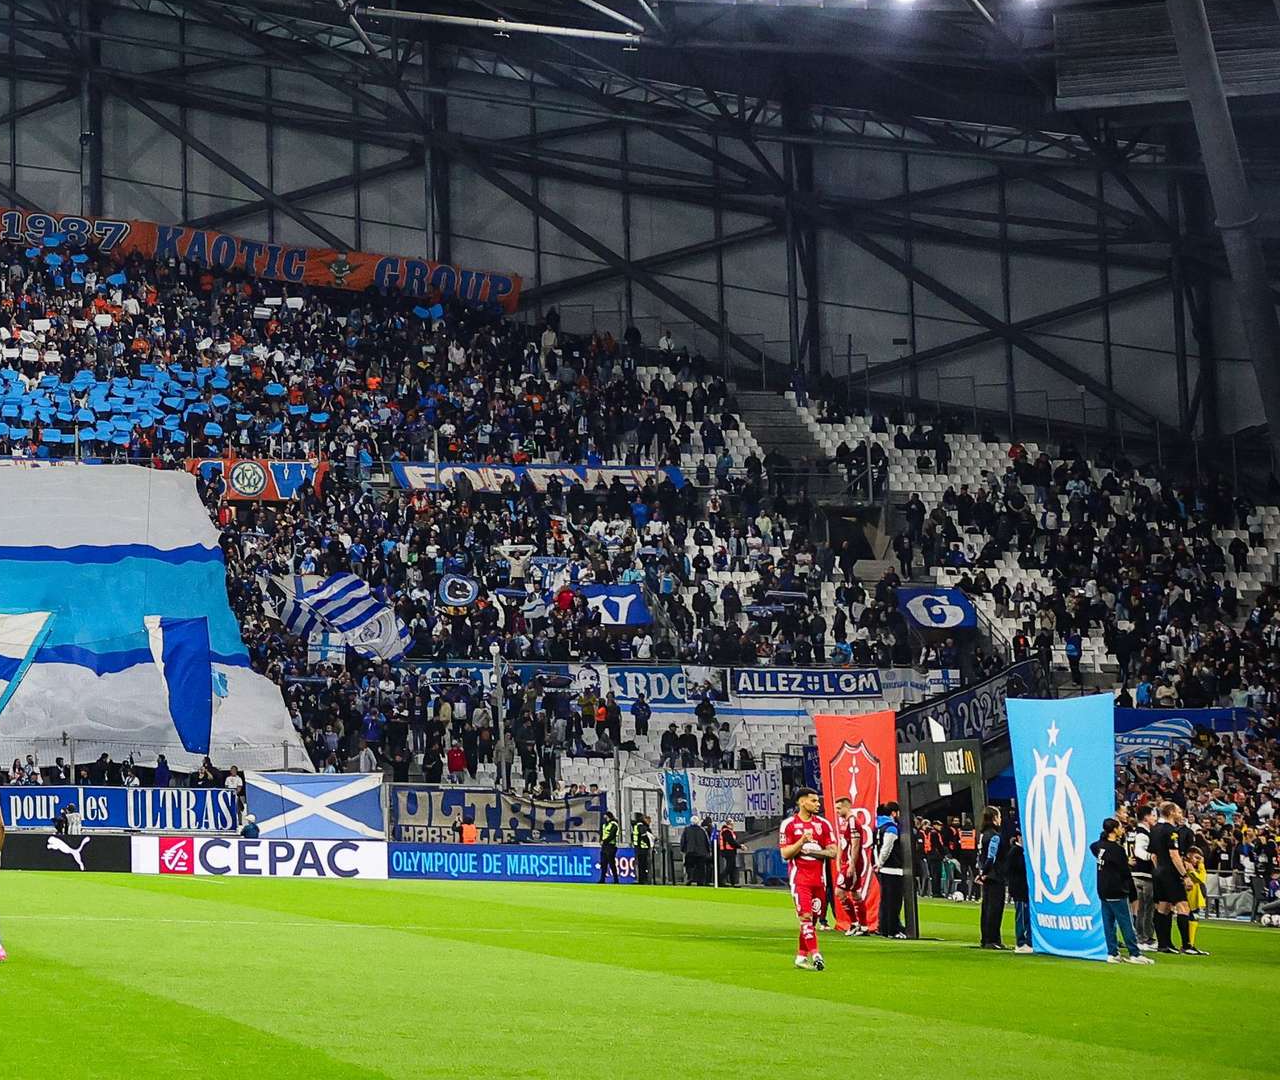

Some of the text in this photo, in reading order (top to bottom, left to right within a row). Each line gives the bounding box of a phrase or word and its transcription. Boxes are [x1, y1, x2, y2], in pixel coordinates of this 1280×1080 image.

[0, 210, 131, 254] 1987
[154, 223, 514, 306] KAOTIC GROUP
[906, 594, 964, 628] G
[738, 672, 806, 692] ALLEZ
[823, 672, 878, 693] L'OM
[957, 686, 1008, 738] 2024
[10, 786, 234, 832] pour les ULTRAS
[397, 790, 602, 832] ULTRAS
[746, 792, 776, 811] MAGIC
[401, 825, 515, 844] MARSLLE
[198, 837, 360, 878] CEPAC
[392, 849, 478, 876] OLYMPIQUE
[482, 852, 502, 874] DE
[506, 852, 591, 878] MARSEILLE
[1057, 914, 1071, 931] AU
[1071, 915, 1093, 932] BUT
